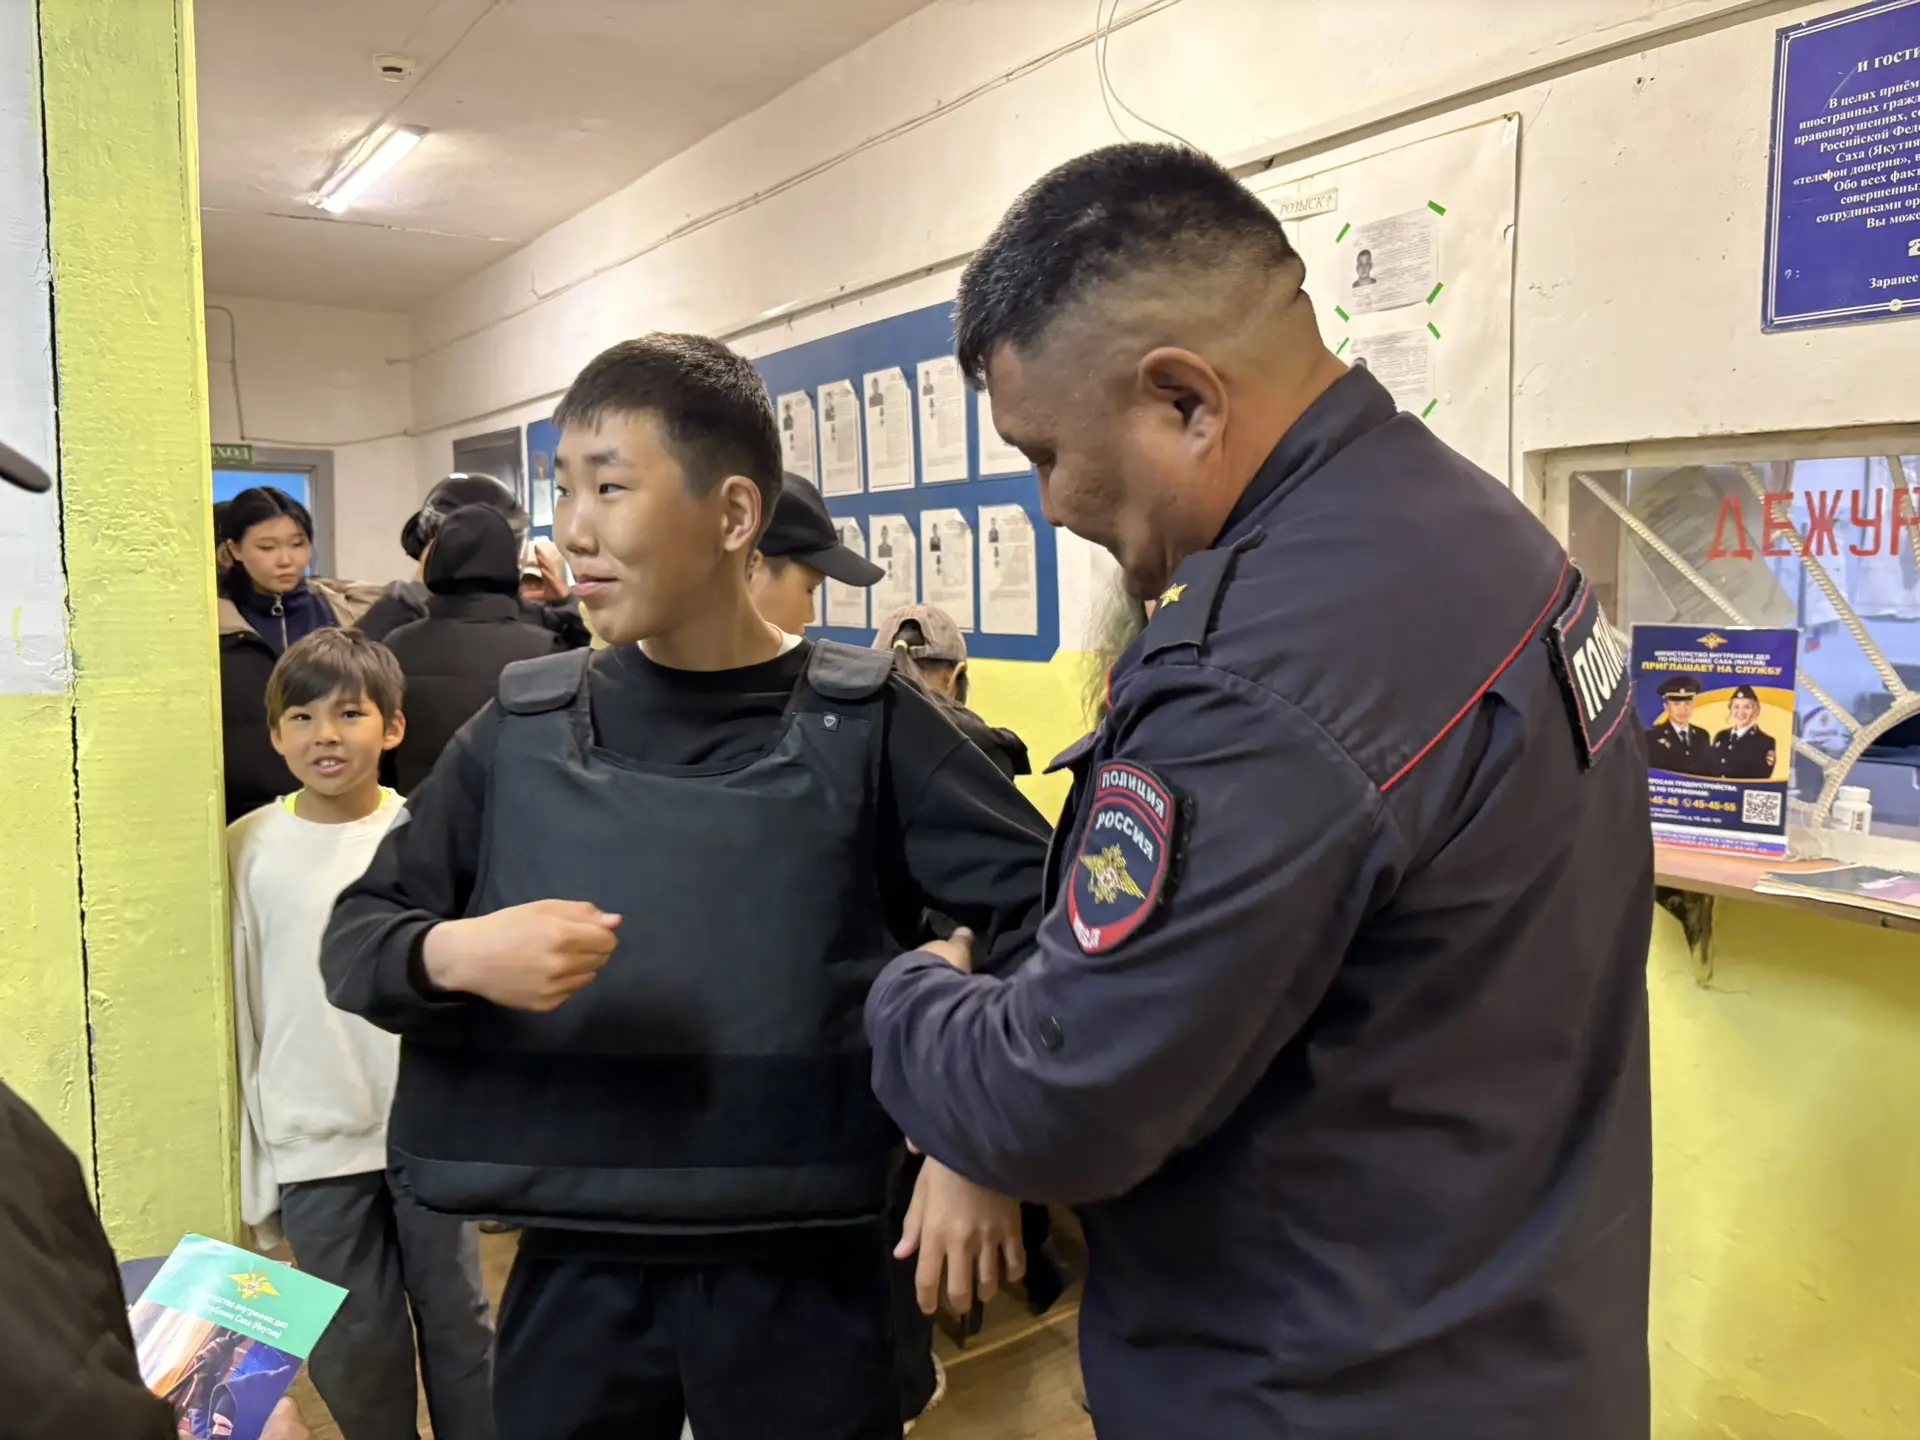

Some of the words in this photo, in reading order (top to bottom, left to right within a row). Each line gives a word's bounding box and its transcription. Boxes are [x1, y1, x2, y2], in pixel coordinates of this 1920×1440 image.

[1857, 60, 1869, 72] и
[1829, 98, 1838, 109] В
[1841, 91, 1876, 106] целях
[1799, 104, 1879, 130] иностранных
[1794, 114, 1908, 146] правонарушениях,
[1820, 129, 1889, 153] Российской
[1893, 124, 1920, 136] Фед
[1835, 151, 1865, 164] Саха
[1793, 169, 1847, 186] «телефон
[1850, 156, 1911, 176] доверия»,
[1834, 179, 1858, 192] Обо
[1860, 175, 1887, 187] всех
[1840, 182, 1920, 205] совершенны
[1816, 201, 1902, 223] сотрудниками
[1866, 217, 1886, 229] Вы
[1868, 274, 1919, 289] Заранее
[1641, 661, 1714, 673] ПРИГЛАШАЕТ
[1717, 664, 1733, 673] НА
[1735, 665, 1782, 676] СЛУЖБУ
[1101, 770, 1165, 818] ПОЛИЦИЯ
[1095, 811, 1154, 861] РОССИЯ
